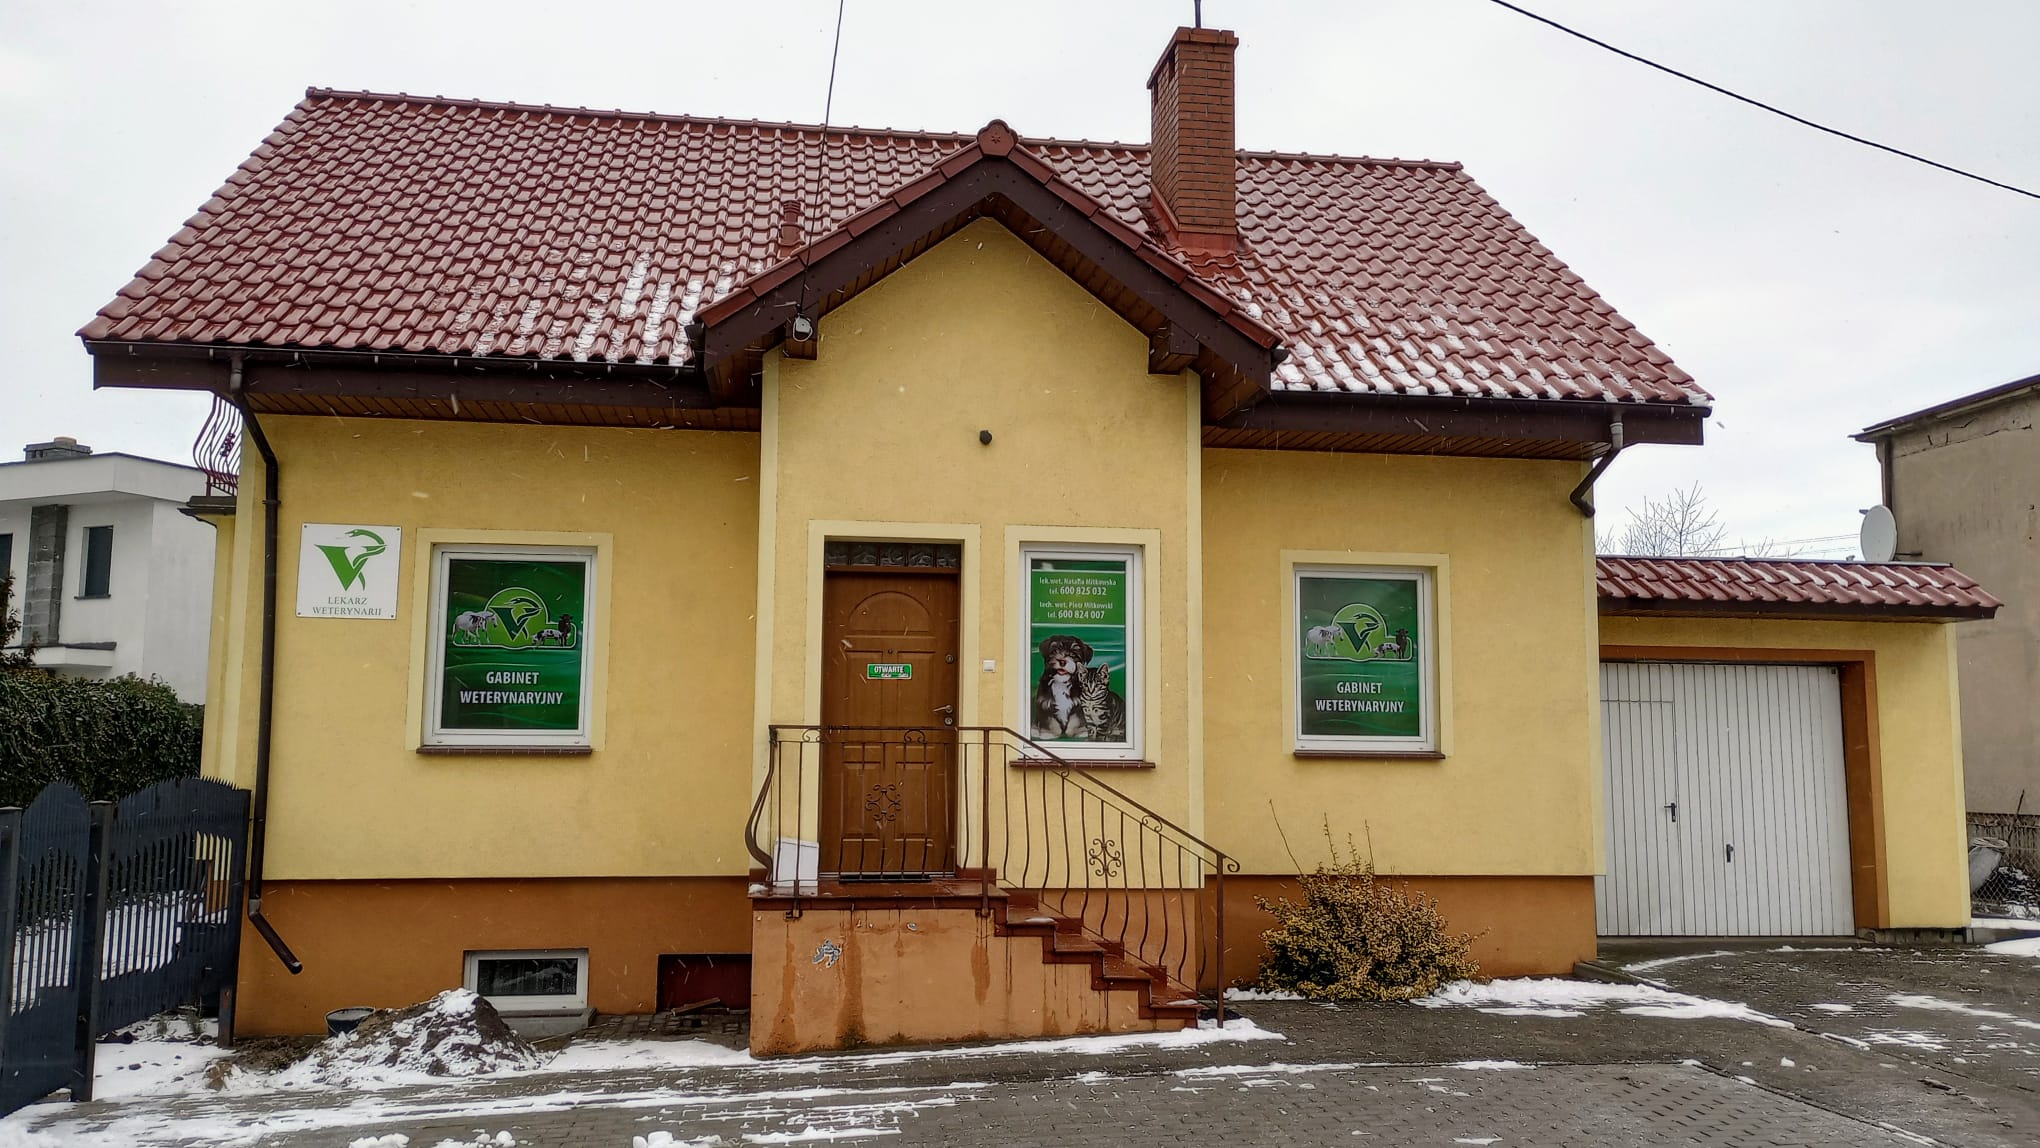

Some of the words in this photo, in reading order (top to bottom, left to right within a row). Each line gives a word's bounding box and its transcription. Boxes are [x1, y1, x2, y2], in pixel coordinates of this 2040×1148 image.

[1060, 586, 1075, 595] 600
[1076, 586, 1091, 596] 825
[1092, 587, 1107, 596] 032
[328, 596, 368, 605] LEKARZ
[312, 606, 381, 616] WETERYNARII
[1058, 610, 1073, 619] 600
[1074, 610, 1089, 619] 824
[1090, 610, 1105, 619] 007
[874, 665, 904, 673] OTWARTE
[486, 671, 540, 685] GABINET
[1336, 681, 1383, 694] GABINET
[459, 690, 563, 705] WETERYNARYJNY
[1315, 699, 1404, 713] WETERYNARYJNY
